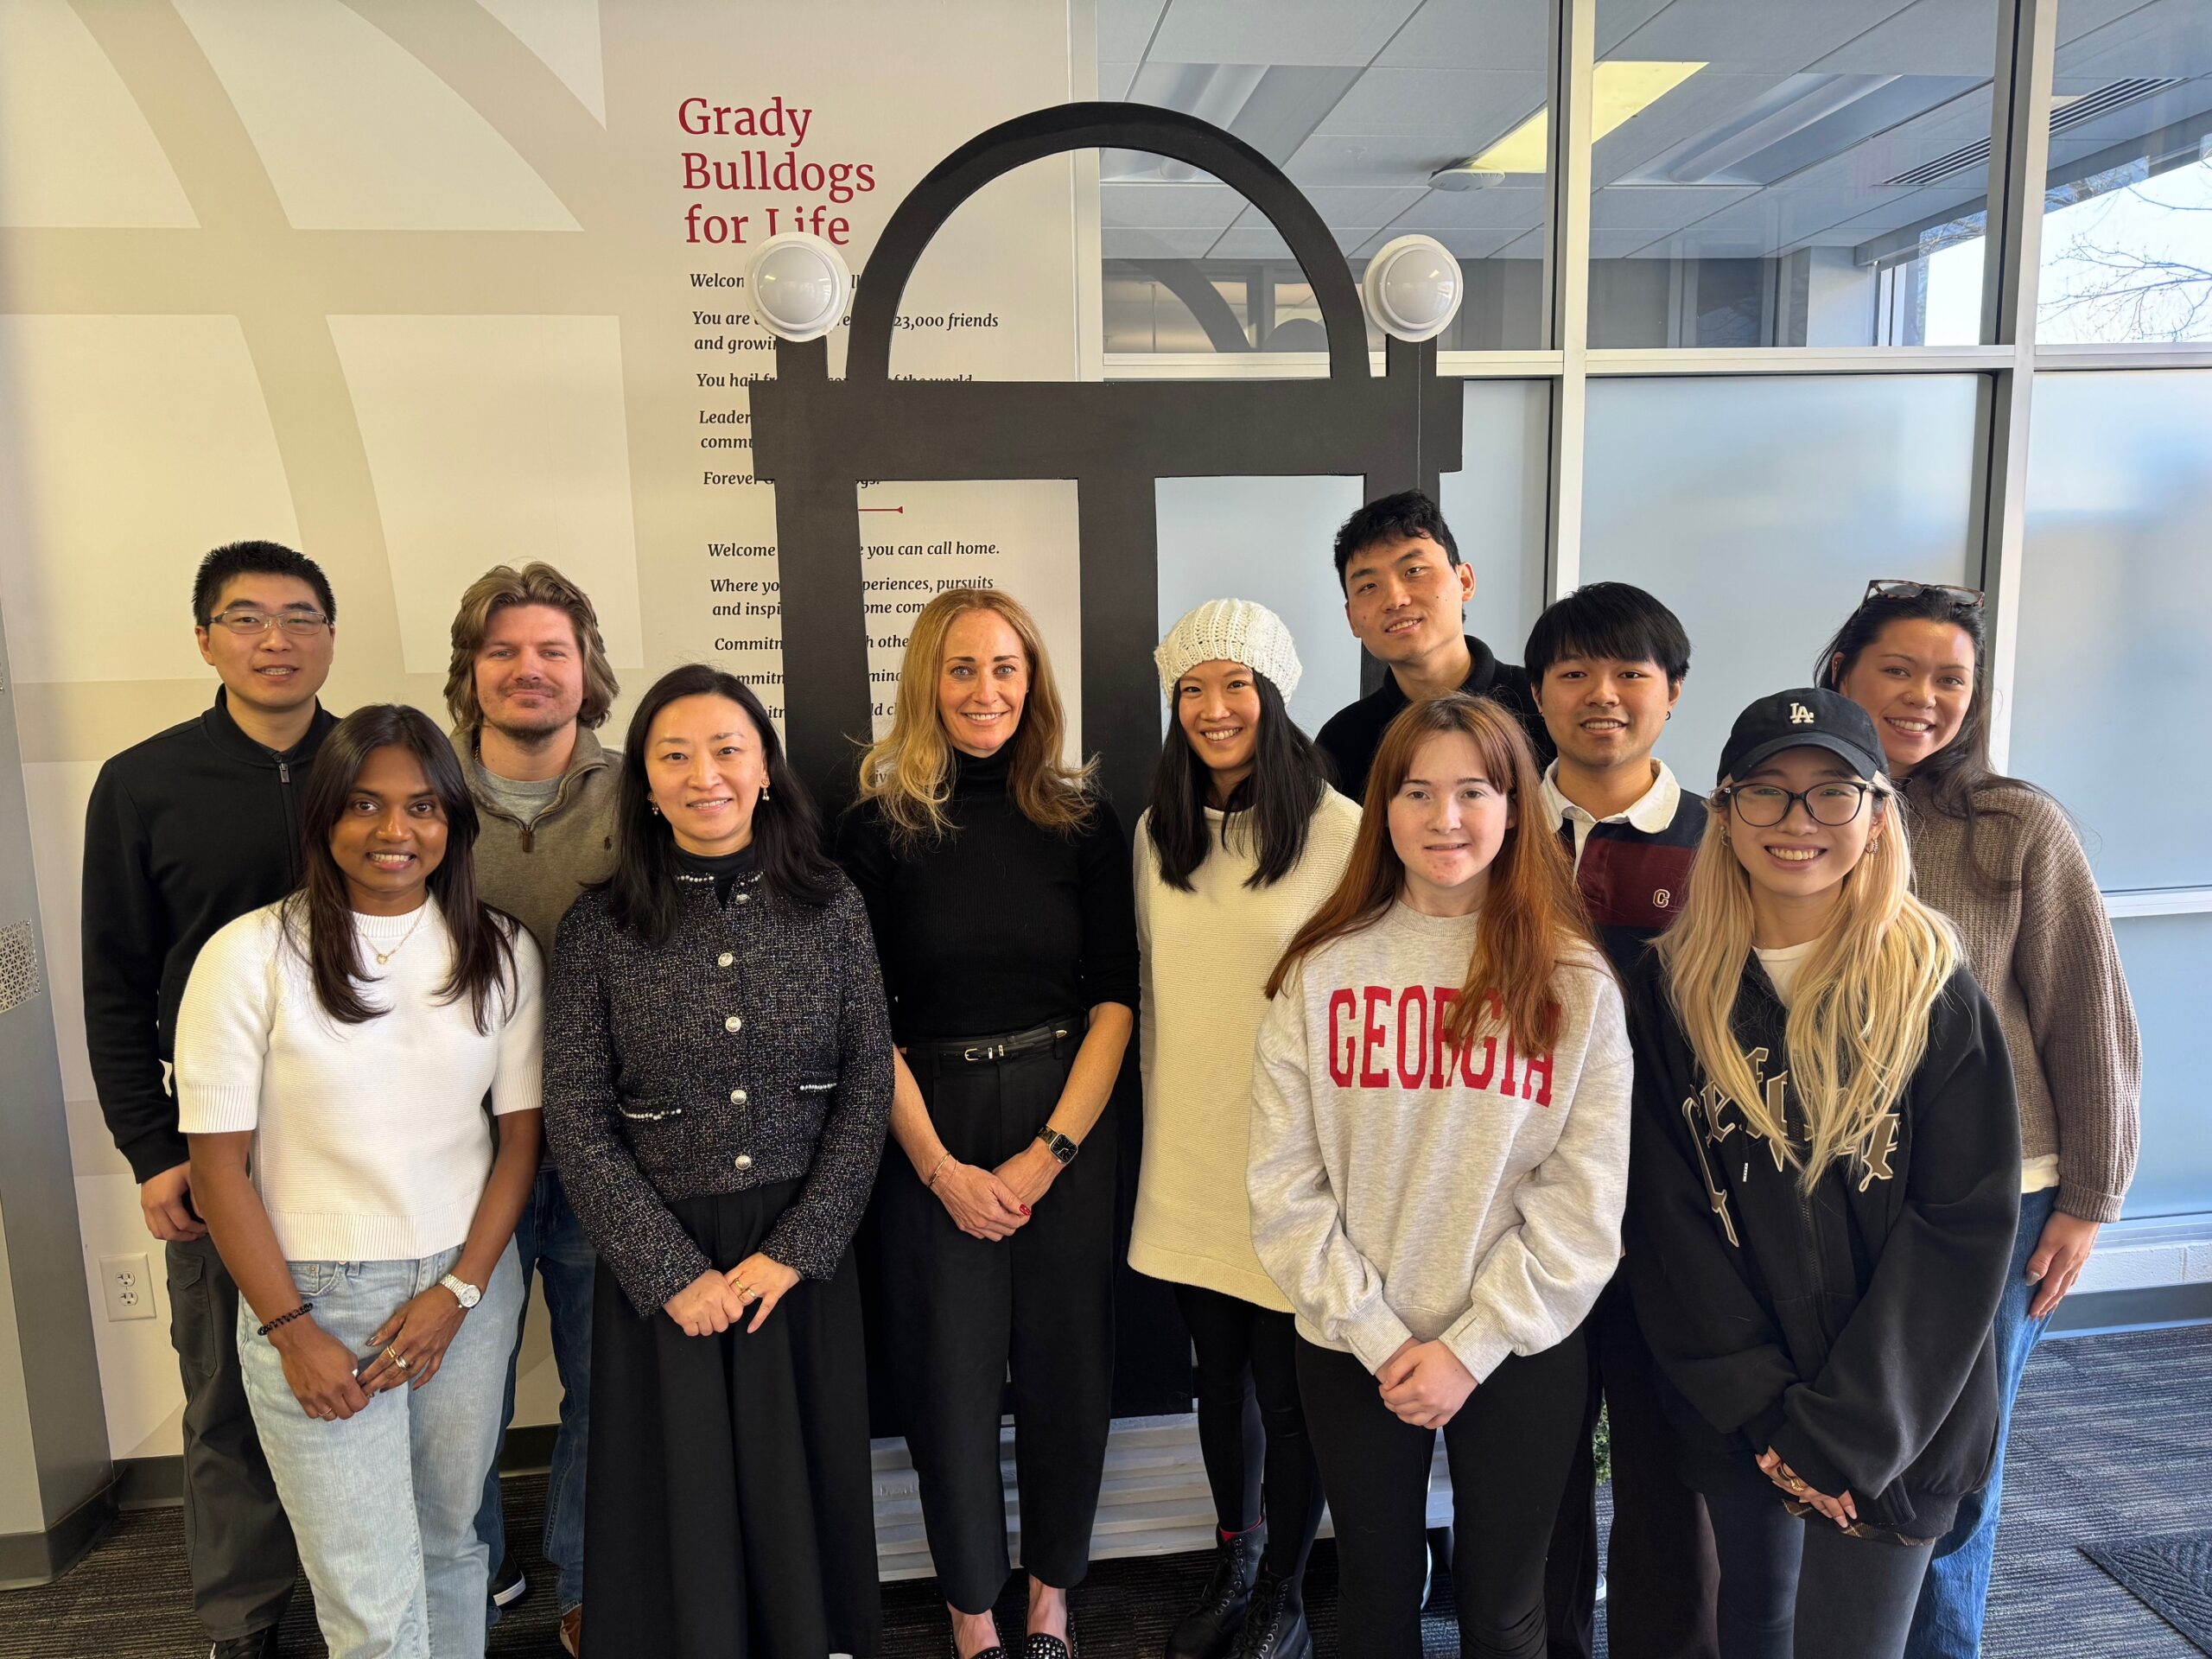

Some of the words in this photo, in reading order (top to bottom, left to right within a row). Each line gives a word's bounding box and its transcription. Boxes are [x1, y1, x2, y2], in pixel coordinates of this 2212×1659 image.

[678, 96, 812, 148] Grady
[681, 150, 875, 203] Bulldogs
[684, 203, 748, 244] for
[692, 311, 721, 325] You
[726, 314, 750, 325] are
[893, 315, 944, 331] 23,000
[947, 313, 999, 331] friends
[694, 336, 723, 350] and
[728, 336, 776, 354] growi
[696, 373, 725, 386] You
[699, 410, 751, 423] Leader
[708, 543, 776, 557] Welcome
[867, 545, 893, 559] you
[898, 544, 923, 556] can
[927, 542, 952, 555] call
[956, 542, 1000, 555] home.
[710, 579, 759, 592] Where
[762, 582, 779, 595] yo
[862, 577, 932, 594] periences,
[937, 575, 994, 593] pursuits
[712, 602, 741, 616] and
[745, 602, 781, 619] inspi
[878, 634, 909, 648] othe
[1789, 702, 1814, 724] LA
[1652, 888, 1670, 908] C
